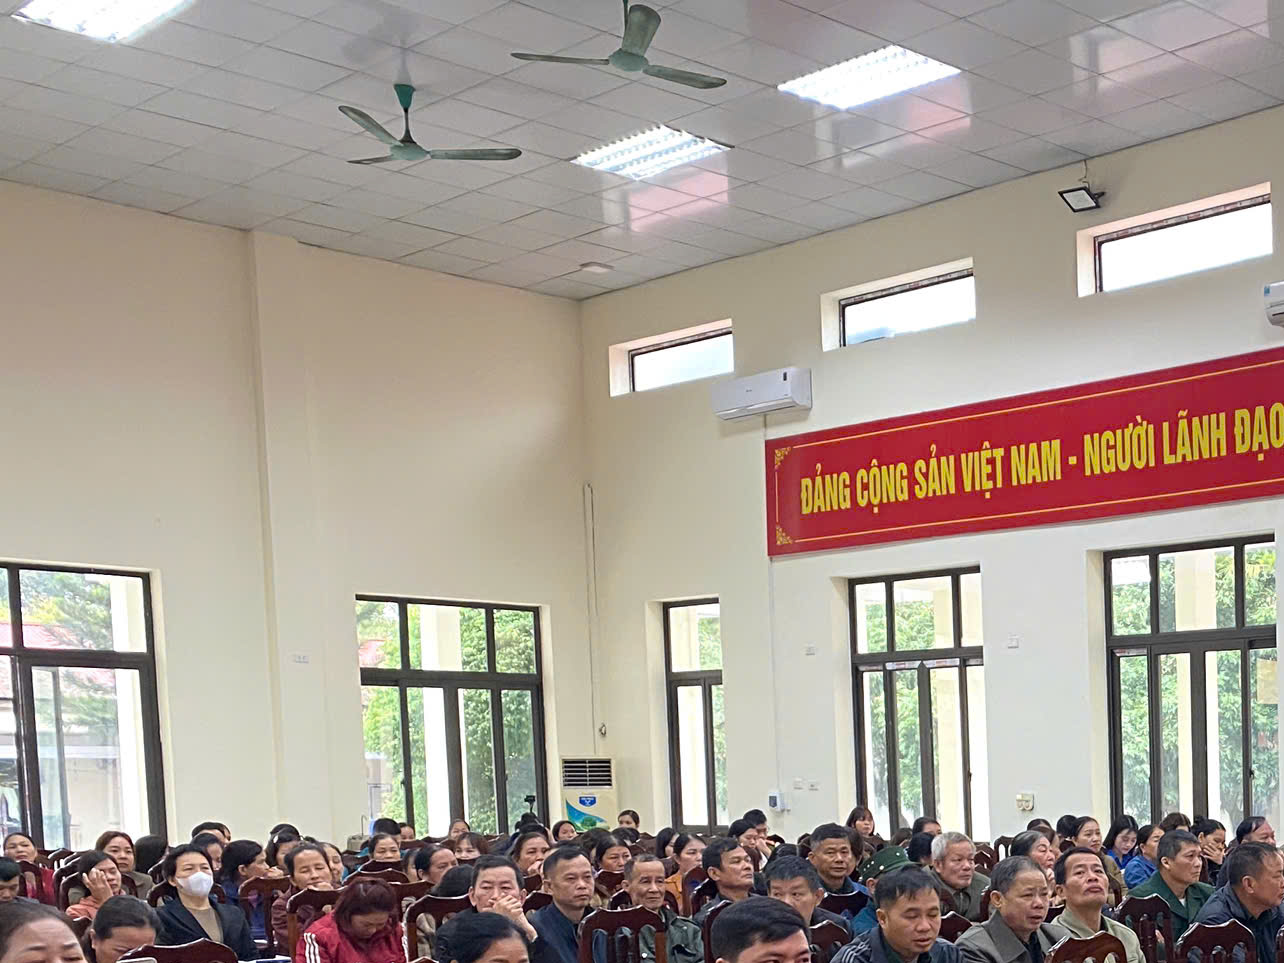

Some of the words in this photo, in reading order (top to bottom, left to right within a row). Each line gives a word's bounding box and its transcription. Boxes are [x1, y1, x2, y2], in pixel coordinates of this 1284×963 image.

[801, 463, 851, 515] ĐẢNG
[857, 458, 908, 514] CỘNG
[915, 443, 956, 499] SẢN
[961, 440, 1005, 499] VIỆT
[1011, 439, 1062, 486] NAM
[1084, 415, 1156, 476] NGƯỜI
[1163, 410, 1227, 465] LÃNH
